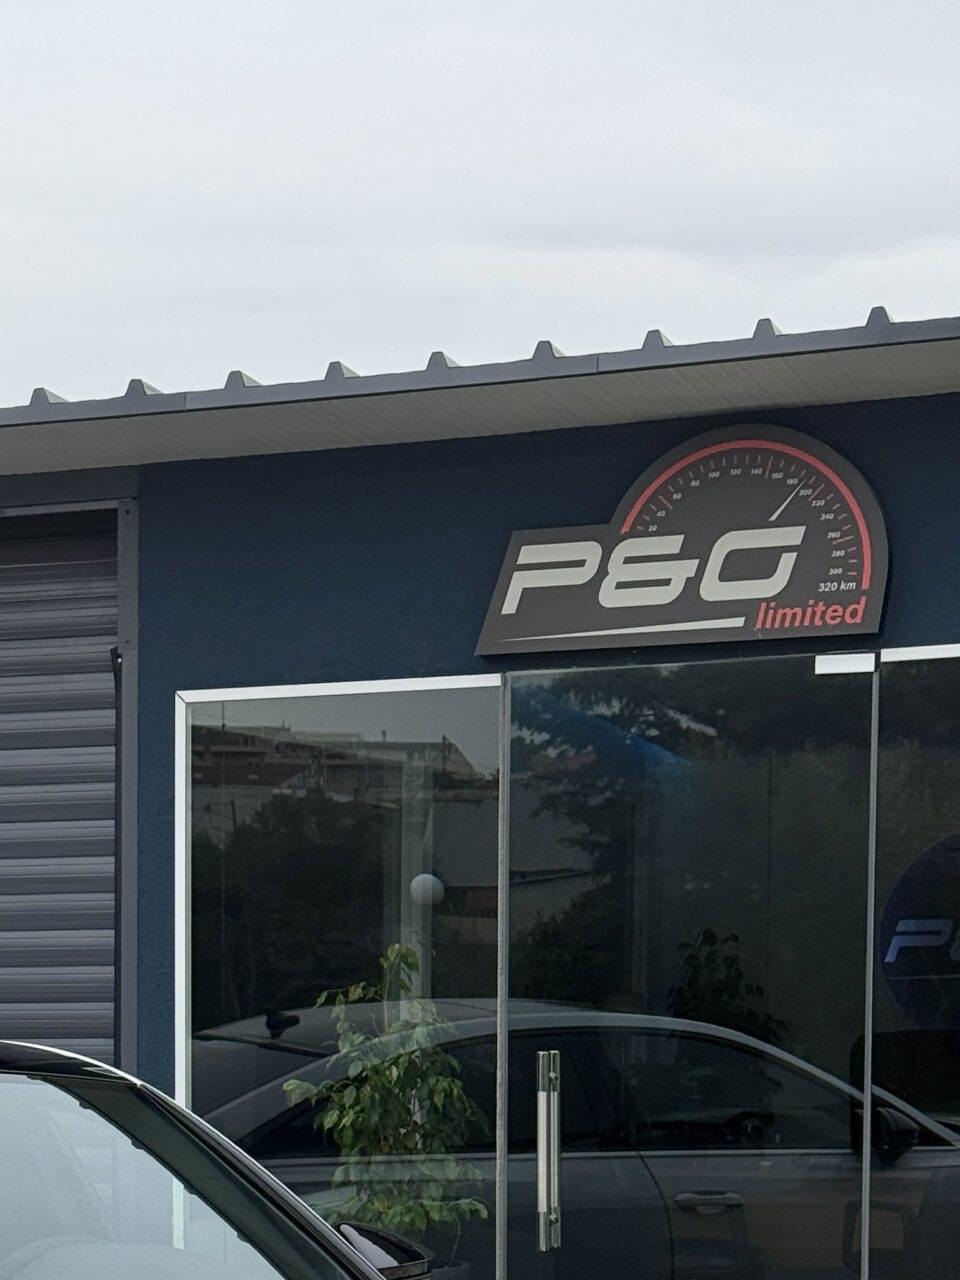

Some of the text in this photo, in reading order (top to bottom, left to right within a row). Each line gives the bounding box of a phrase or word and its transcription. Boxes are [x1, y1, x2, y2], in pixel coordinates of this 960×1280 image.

[818, 580, 856, 592] 320 km
[755, 596, 867, 629] limited
[884, 918, 960, 963] P
